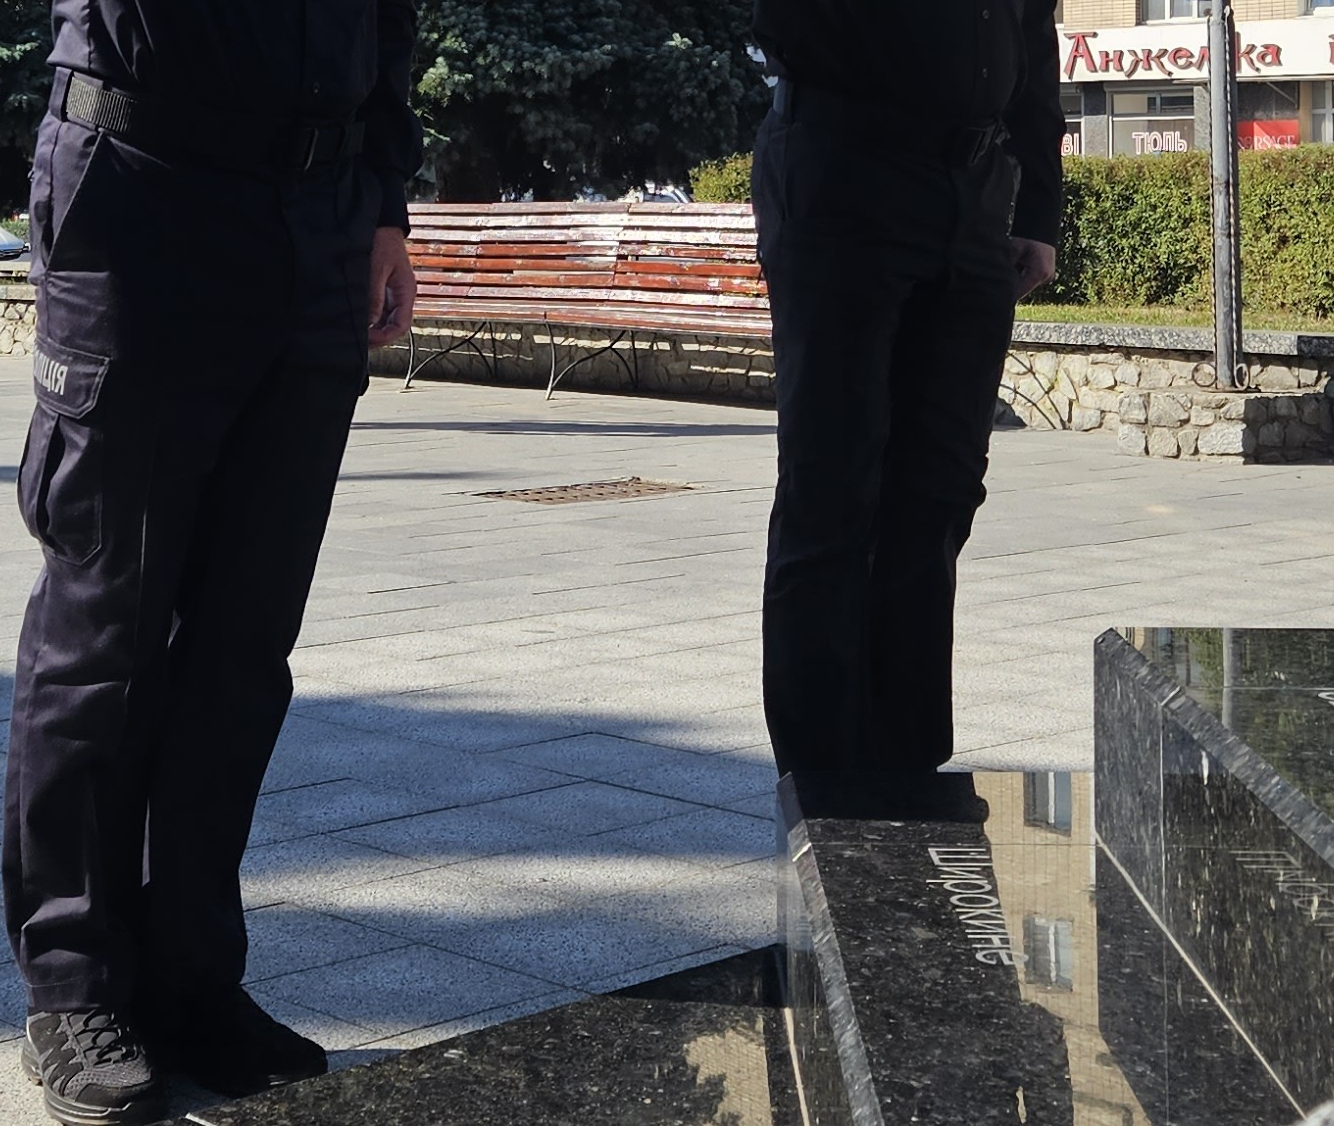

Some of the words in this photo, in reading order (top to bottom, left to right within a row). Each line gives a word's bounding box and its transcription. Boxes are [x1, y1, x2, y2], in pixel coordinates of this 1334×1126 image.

[1064, 31, 1283, 80] Анжелка
[1132, 131, 1187, 155] ТЮЛЬ
[926, 848, 1029, 966] Широкине
